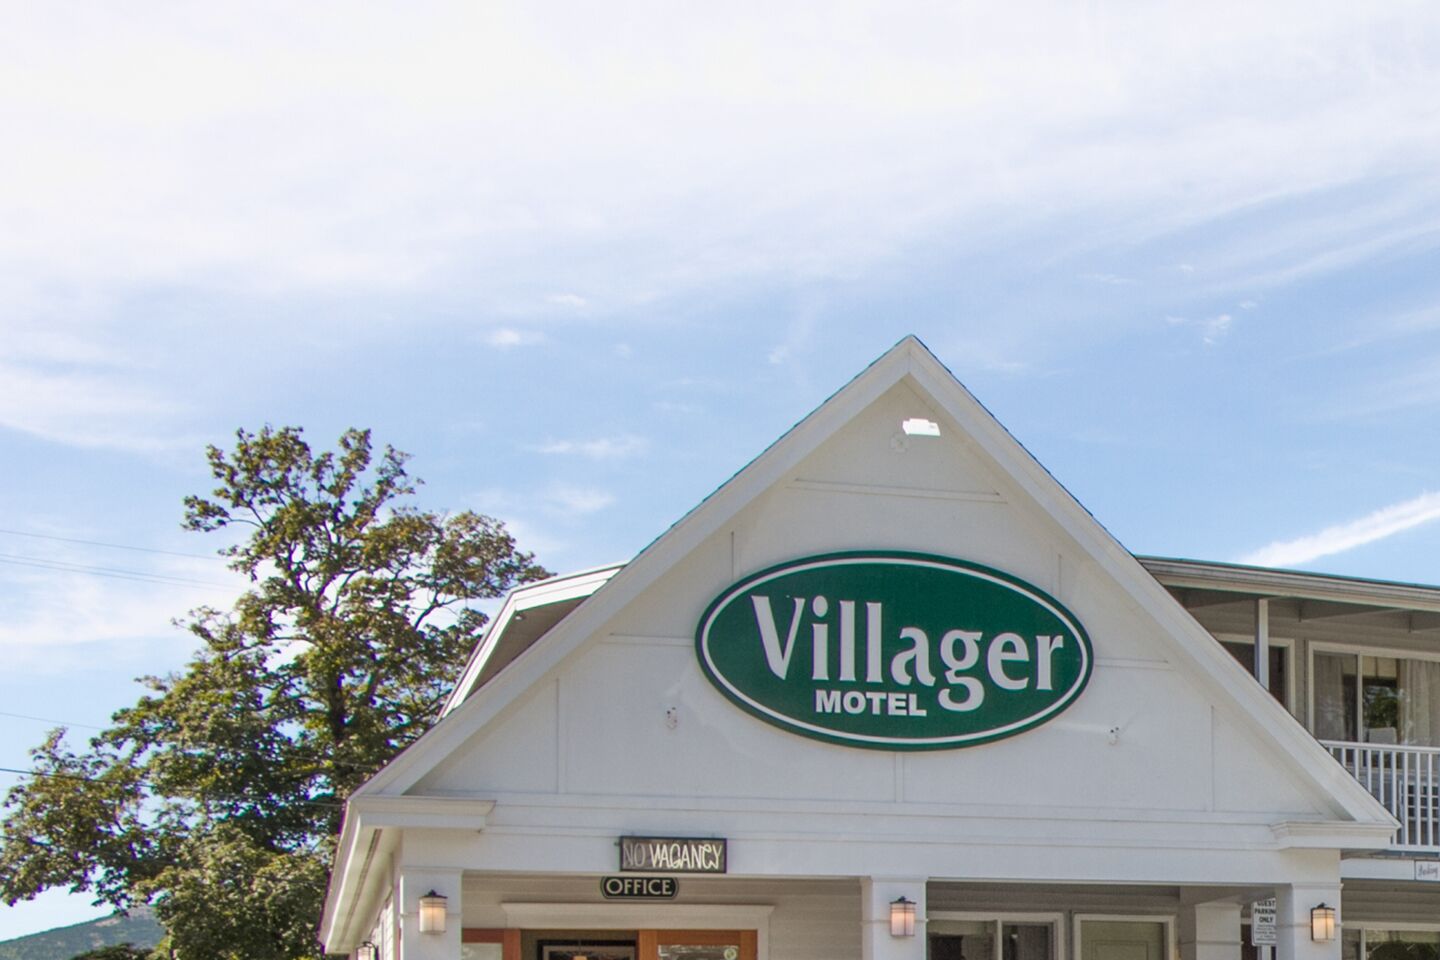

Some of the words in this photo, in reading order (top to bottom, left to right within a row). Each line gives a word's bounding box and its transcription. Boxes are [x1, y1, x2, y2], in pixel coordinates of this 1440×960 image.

[750, 594, 1064, 712] Villager
[814, 689, 928, 717] MOTEL
[623, 842, 646, 867] NO
[649, 843, 722, 870] VACANCY
[605, 878, 673, 896] OFFICE
